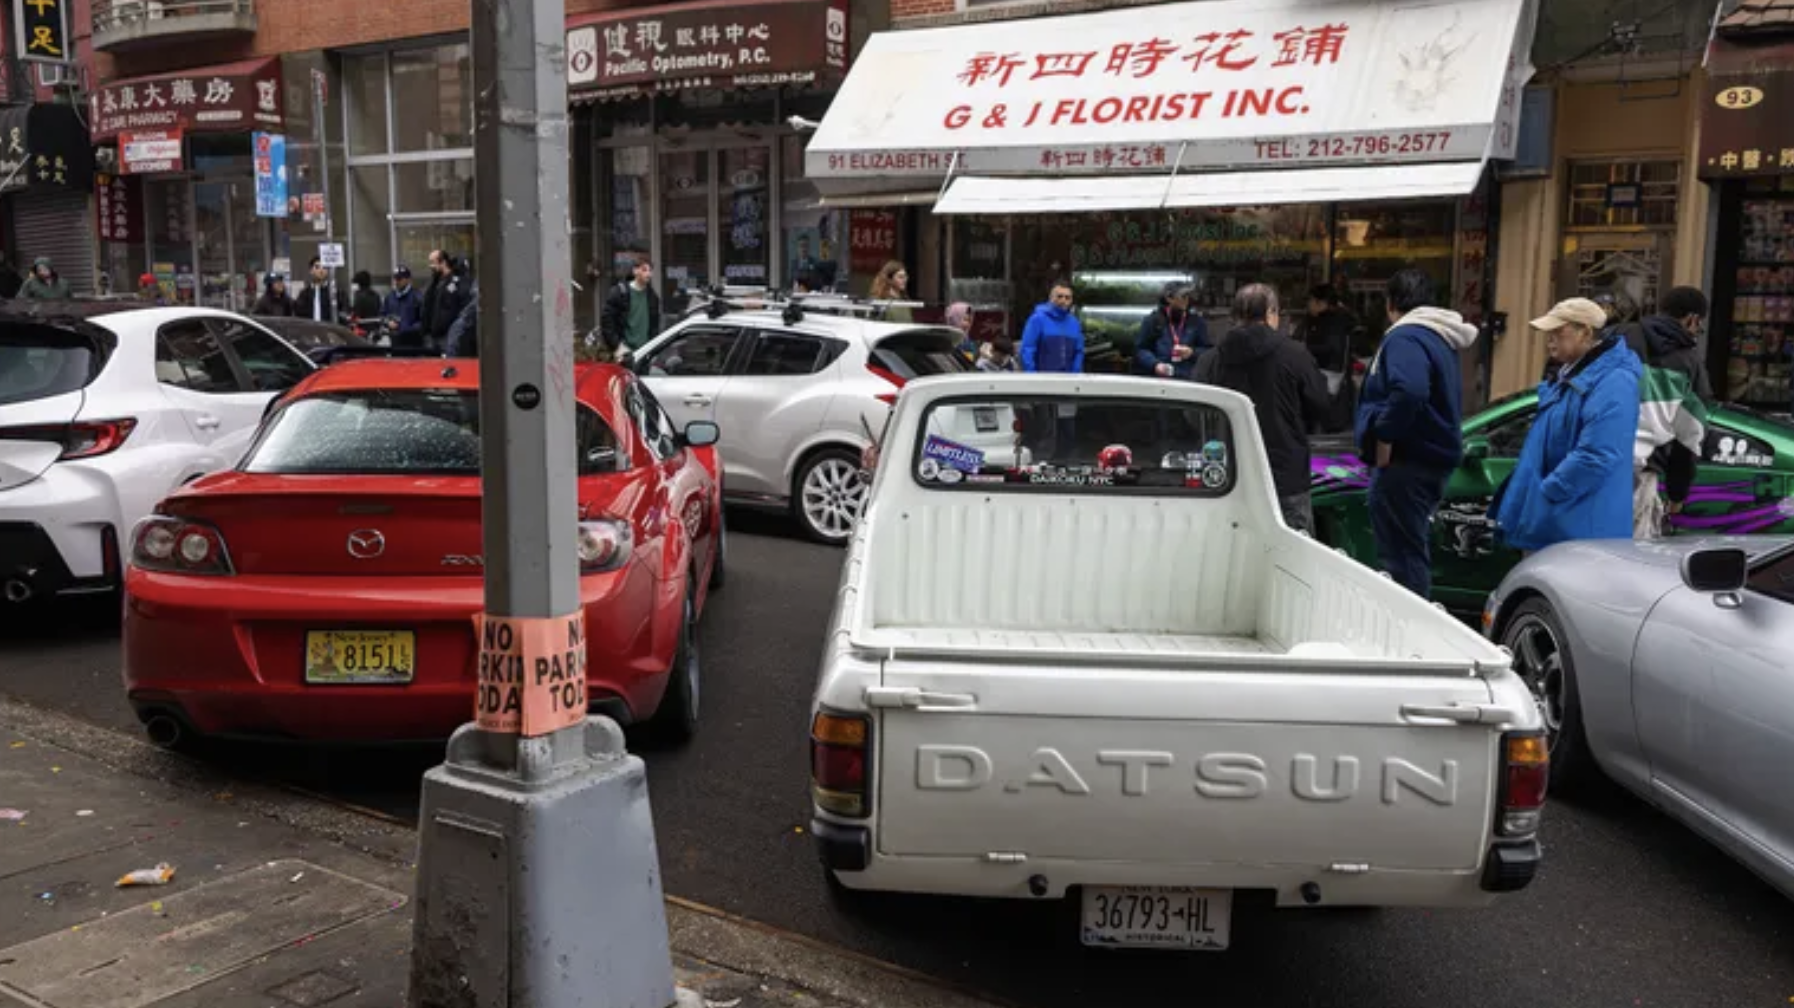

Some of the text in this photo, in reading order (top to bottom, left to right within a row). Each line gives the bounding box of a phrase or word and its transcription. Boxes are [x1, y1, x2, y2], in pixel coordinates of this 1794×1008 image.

[604, 48, 770, 77] Pacific Optometry, P.C.
[956, 22, 1350, 87] 新四時花鋪
[943, 86, 1311, 129] G & J FLORIST INC.
[1727, 89, 1752, 106] 93
[1041, 145, 1166, 168] 新四時花鋪
[1254, 132, 1451, 158] TEL: 212-796-2577
[828, 154, 844, 169] 91
[851, 152, 939, 169] ELIZABETH
[484, 620, 513, 651] NO
[344, 644, 395, 671] 8151
[914, 743, 1458, 806] DATSUN
